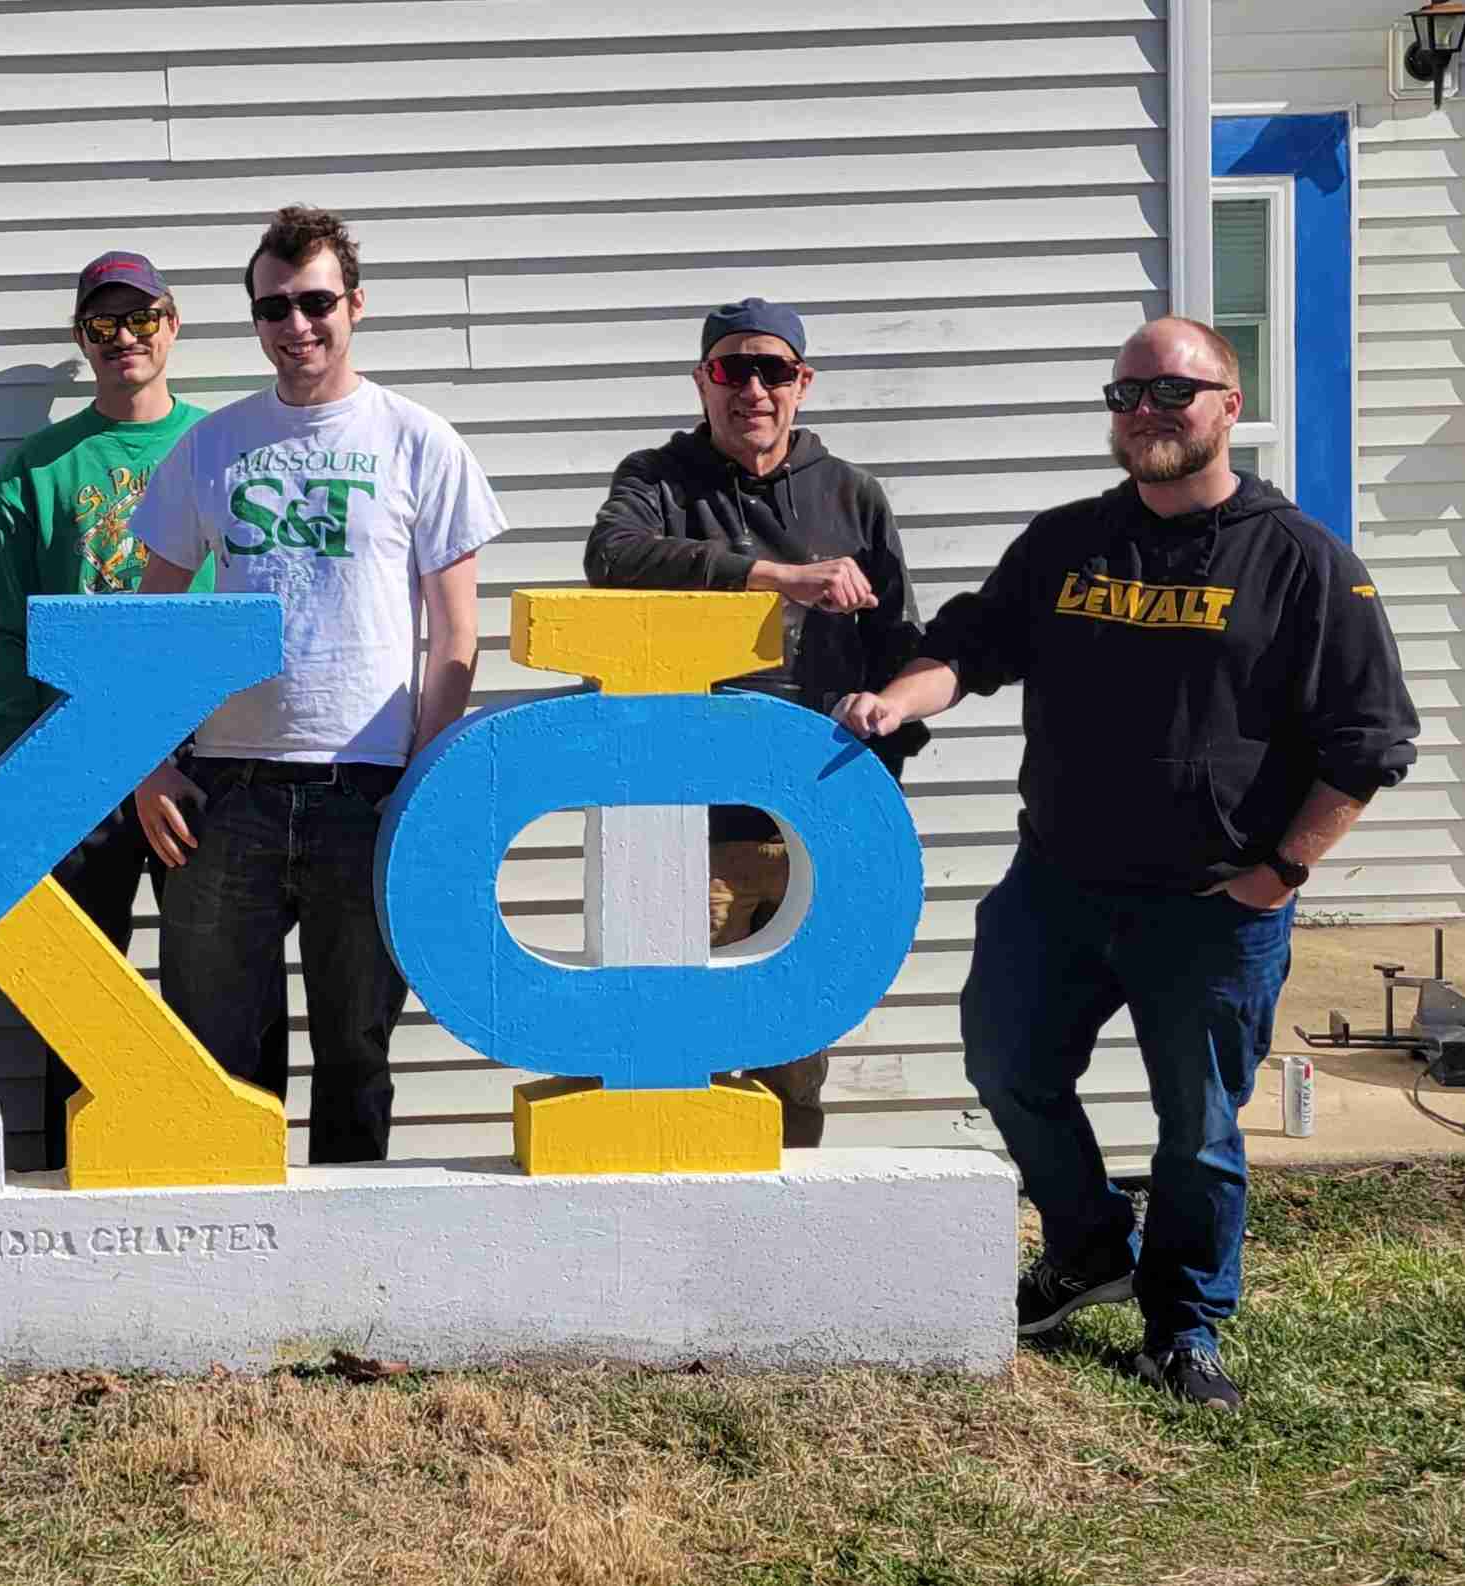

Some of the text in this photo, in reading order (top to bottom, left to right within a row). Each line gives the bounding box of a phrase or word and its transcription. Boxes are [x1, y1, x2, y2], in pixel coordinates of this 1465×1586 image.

[235, 449, 378, 474] MISSOURI
[224, 478, 375, 558] S&T
[87, 1223, 279, 1257] CHAPTER
